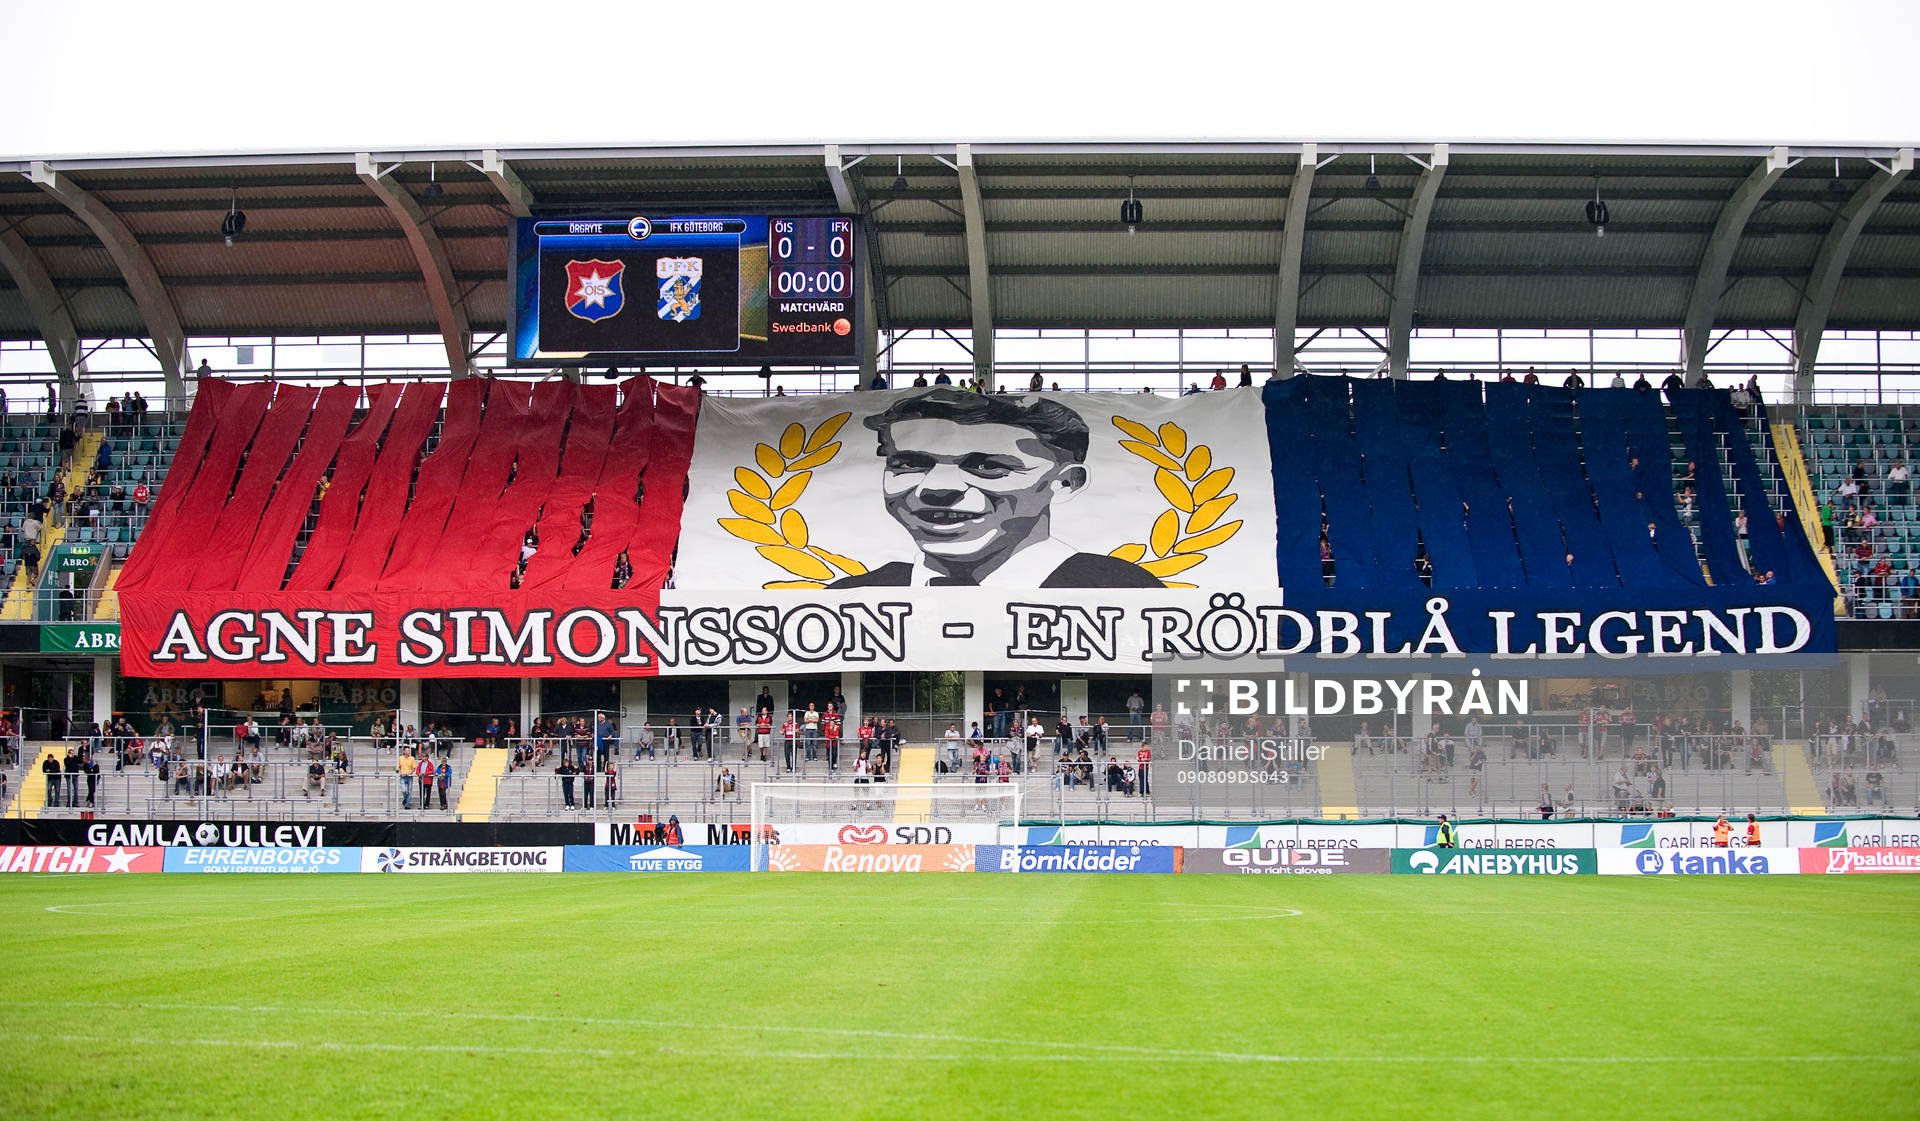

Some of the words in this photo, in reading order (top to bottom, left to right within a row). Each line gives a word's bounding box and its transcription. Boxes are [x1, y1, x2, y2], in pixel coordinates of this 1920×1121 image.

[569, 223, 603, 234] ÖRGRYTE
[670, 222, 683, 232] IFK
[684, 221, 723, 232] GÖTEBORG
[775, 220, 793, 233] ÖIS
[831, 222, 849, 233] IFK
[778, 237, 792, 258] 0
[830, 236, 845, 258] 0
[584, 281, 605, 296] ÖIS
[777, 271, 845, 293] 00:00
[780, 300, 844, 312] MATCHVÄRD
[772, 322, 832, 333] Swedbank
[62, 558, 89, 567] ÅBRO
[150, 608, 378, 666] AGNE
[398, 602, 912, 667] SIMONSSON
[1006, 602, 1124, 661] EN
[1141, 592, 1466, 661] RÖDBLÅ
[1487, 605, 1813, 660] LEGEND
[75, 630, 121, 648] ÅBR
[88, 824, 193, 846] GAMLA
[223, 825, 325, 847] ULLEVI
[895, 826, 952, 844] SDD
[184, 849, 341, 865] EHRENBORGS
[408, 849, 547, 866] STRÄNGBETONG
[823, 846, 922, 872] Renova
[1440, 854, 1579, 874] ANEBYHUS
[1670, 850, 1769, 874] tanka
[203, 865, 229, 873] GOLV
[629, 860, 663, 871] TUVE
[667, 860, 703, 871] BYGG
[1240, 866, 1262, 874] The
